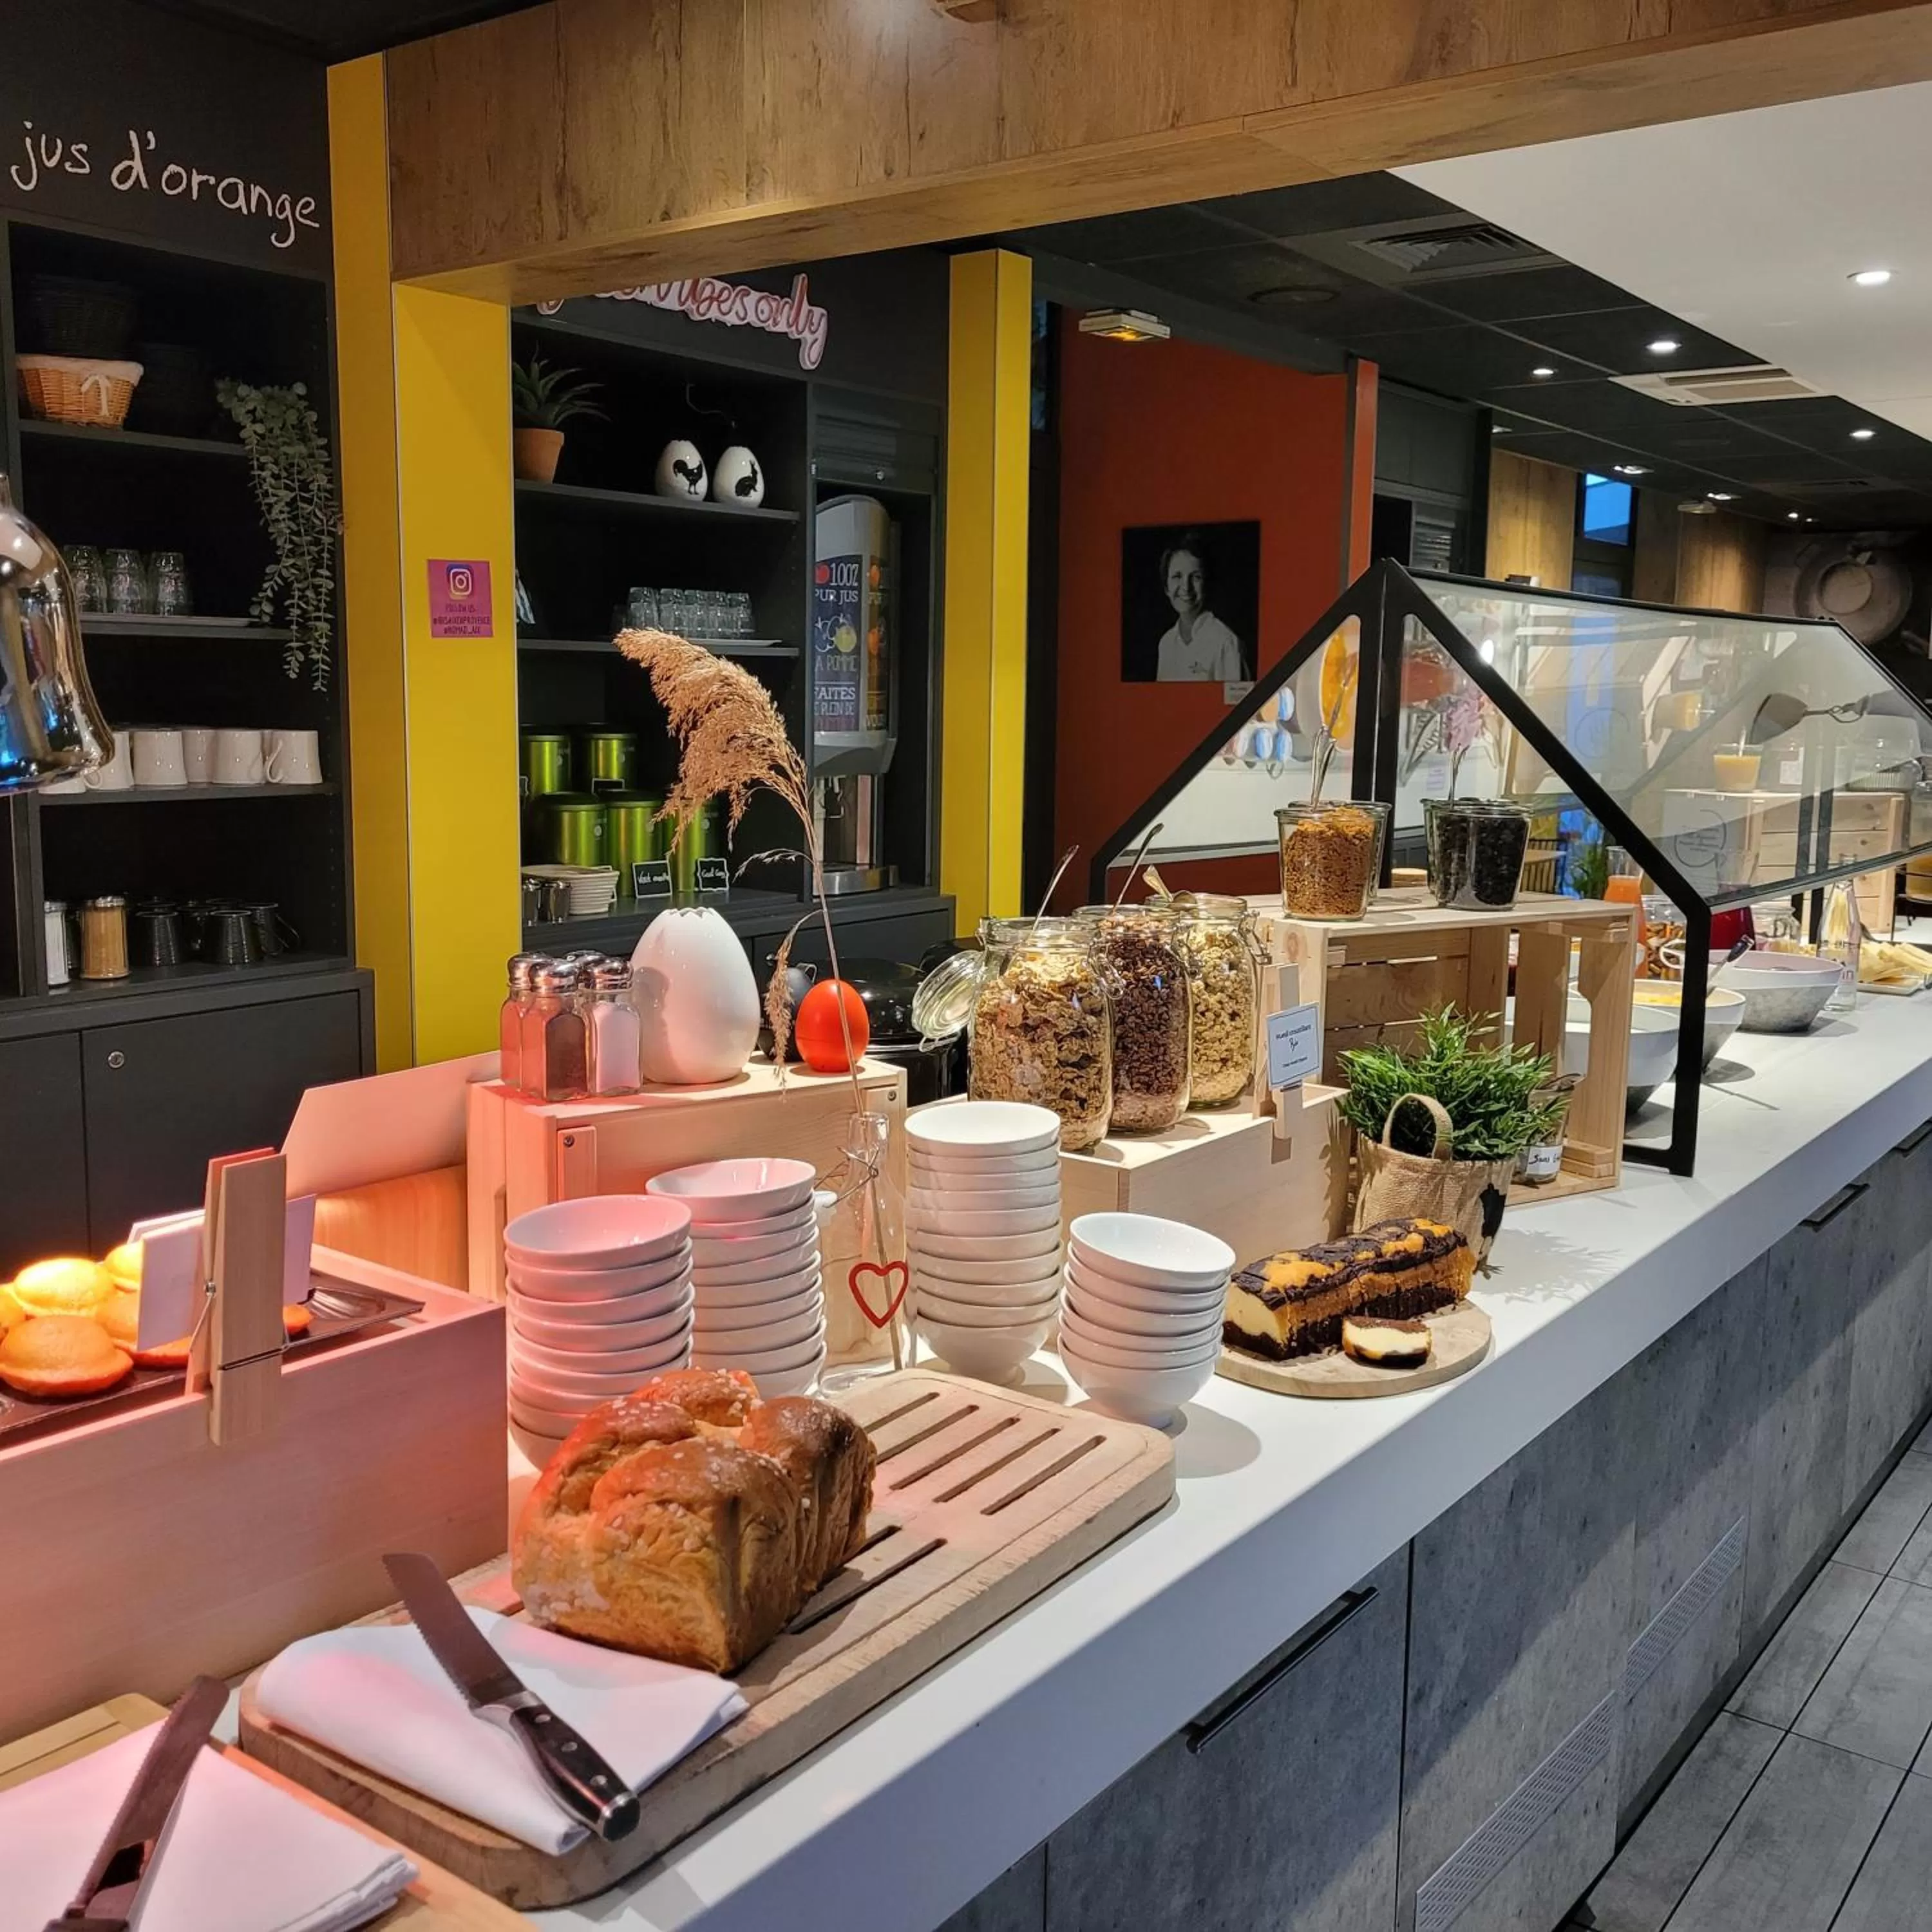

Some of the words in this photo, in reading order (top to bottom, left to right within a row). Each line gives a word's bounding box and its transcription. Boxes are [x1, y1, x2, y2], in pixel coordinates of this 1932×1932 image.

[10, 120, 91, 191] jus
[110, 129, 320, 248] d'orange
[754, 273, 828, 370] only
[838, 589, 858, 605] JUS
